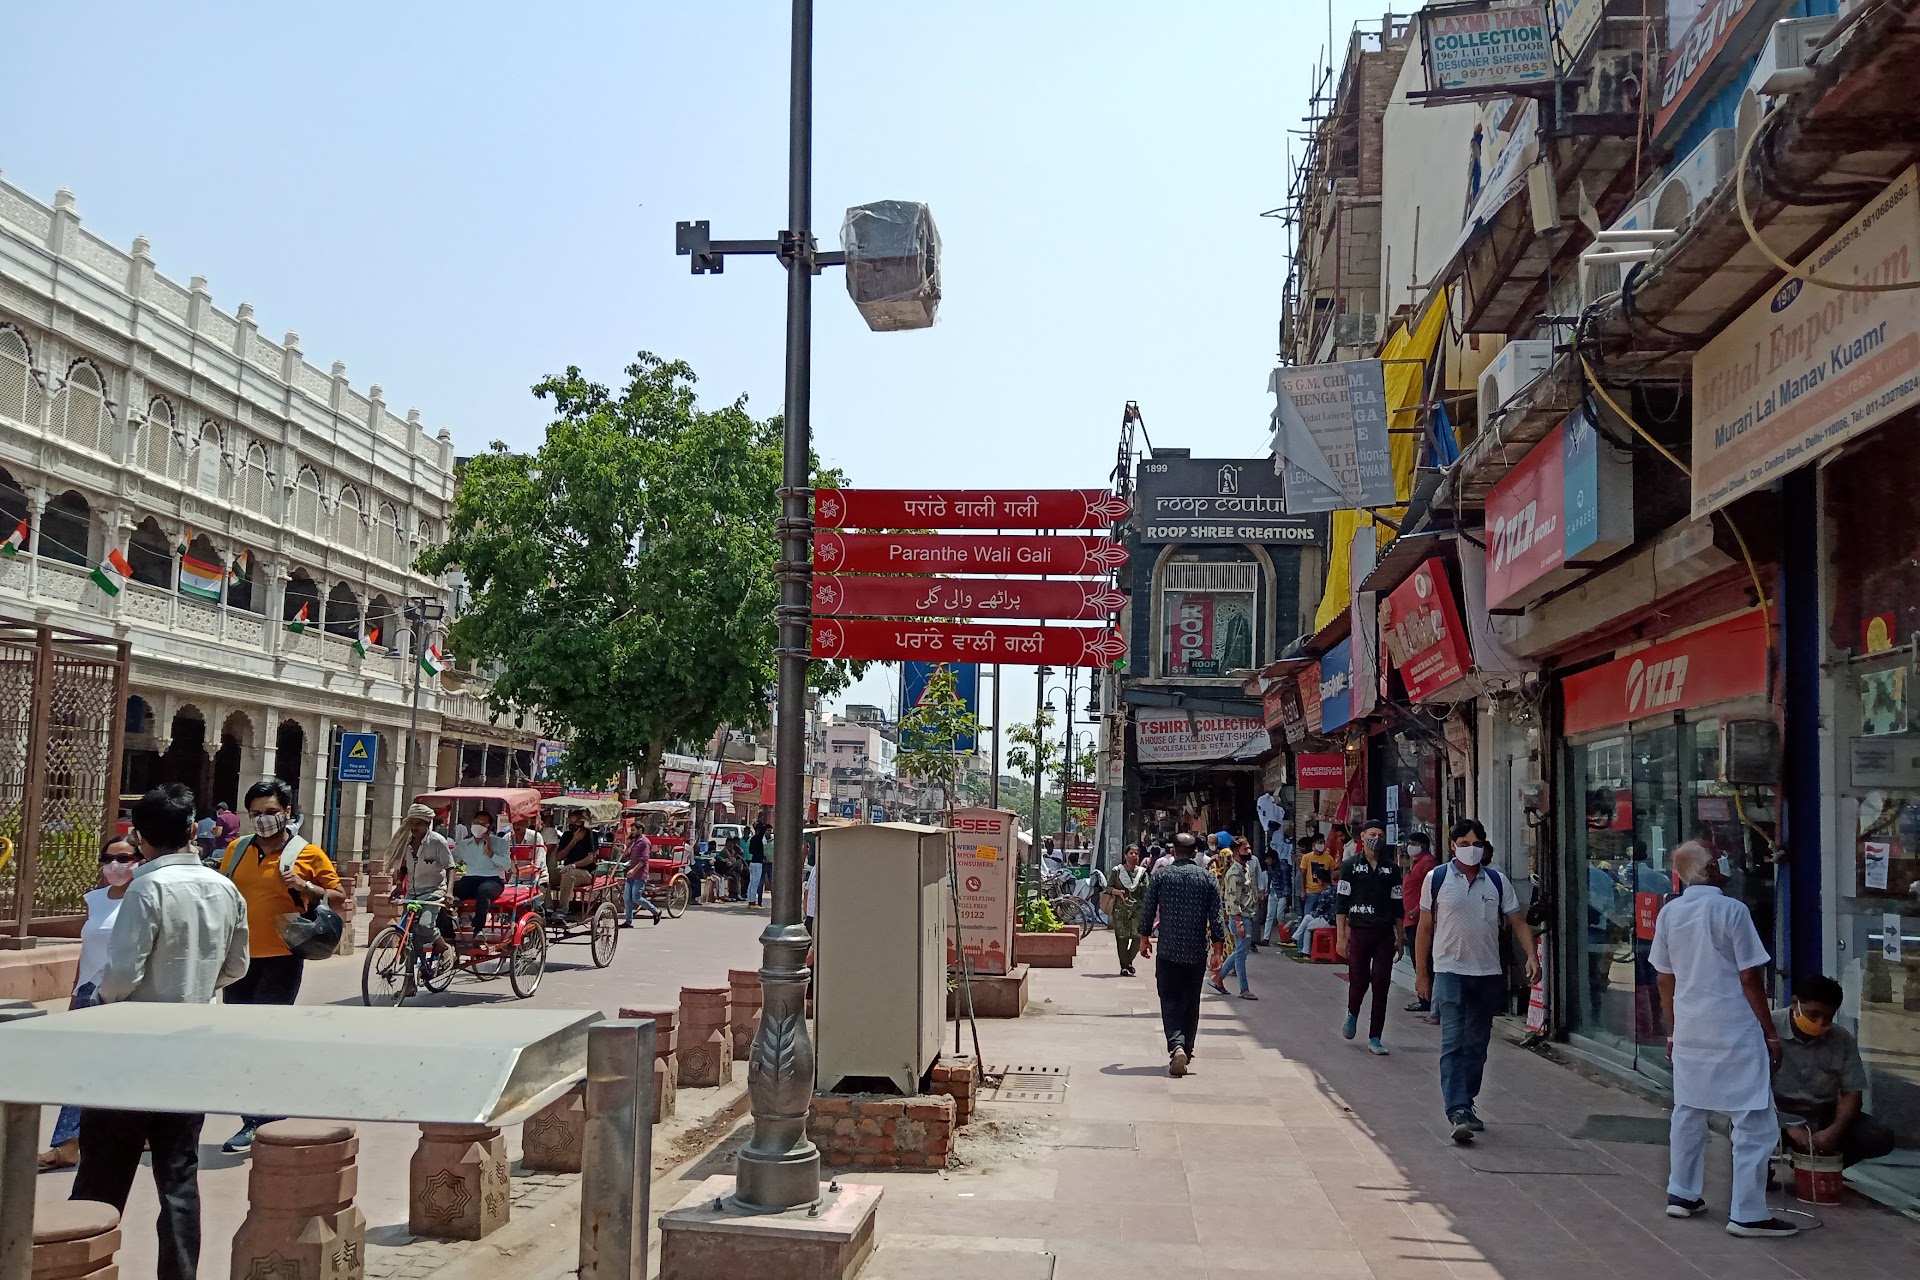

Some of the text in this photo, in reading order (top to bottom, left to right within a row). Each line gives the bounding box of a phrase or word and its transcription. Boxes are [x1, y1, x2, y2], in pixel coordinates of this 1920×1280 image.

[1495, 9, 1540, 29] HARI
[1434, 27, 1543, 51] COLLECTION
[1436, 50, 1458, 61] 1967
[1487, 45, 1500, 54] III
[1504, 42, 1545, 53] FLOOR
[1436, 51, 1547, 71] DESIGNER SHERWANI
[1461, 62, 1548, 79] 9971076853
[1776, 280, 1798, 309] 1970
[1768, 244, 1911, 376] Emporium
[1715, 406, 1752, 449] Murari
[1757, 390, 1776, 423] Lal
[1780, 361, 1826, 407] Manav
[1830, 321, 1887, 374] Kuamr
[1352, 390, 1378, 405] RA
[1355, 408, 1380, 423] GA
[1360, 446, 1388, 462] tional
[1765, 451, 1785, 472] Central
[1145, 464, 1168, 473] 1899
[1360, 464, 1389, 478] RWANI
[904, 494, 1040, 518] परांठे वाली गली
[1157, 494, 1286, 517] roop coutu
[1534, 515, 1557, 544] WORLD
[1566, 507, 1596, 537] CAPRESE
[1147, 526, 1315, 540] ROOP SHREE CREATIONS
[889, 544, 1051, 563] Paranthe Wali Gali
[915, 584, 942, 609] گلی
[944, 589, 973, 610] والی
[895, 627, 1045, 653] ਪਰਾਂਠੇ ਵਾਲੀ ਗਲੀ
[1191, 660, 1217, 668] ROOP
[1644, 655, 1689, 709] VIP
[1180, 734, 1224, 743] EXCLUSIVE
[961, 911, 984, 919] 19122
